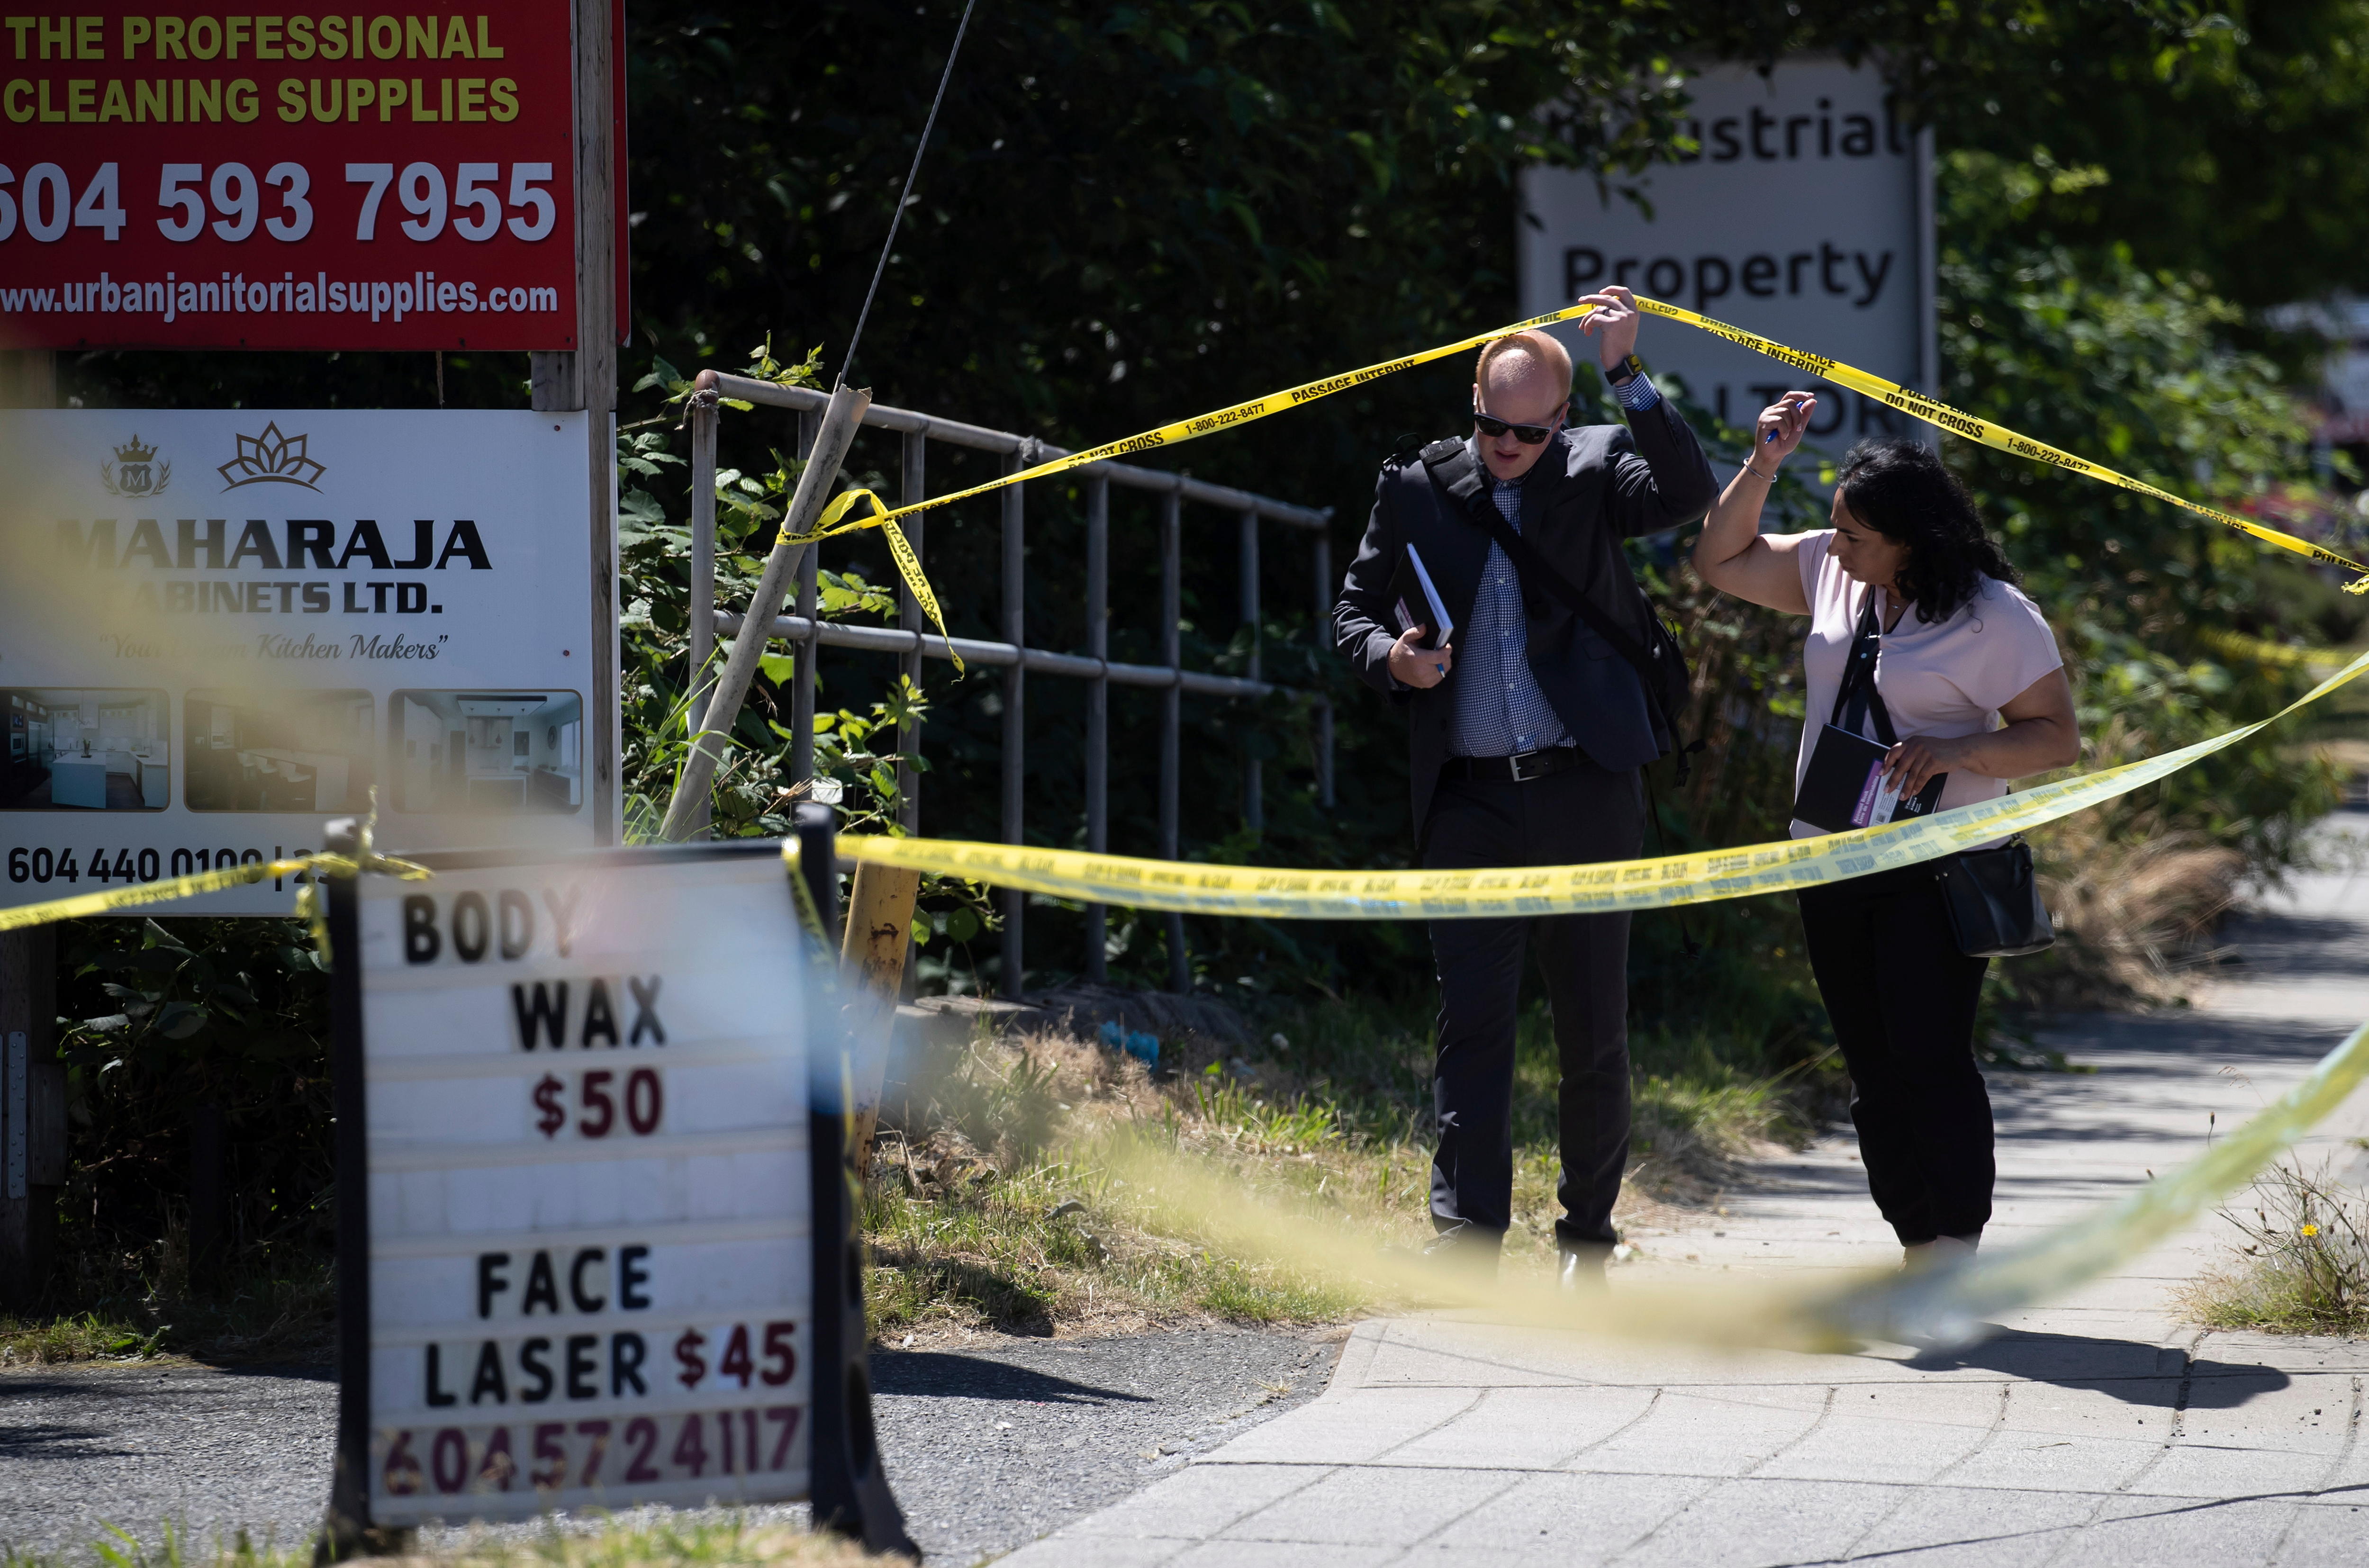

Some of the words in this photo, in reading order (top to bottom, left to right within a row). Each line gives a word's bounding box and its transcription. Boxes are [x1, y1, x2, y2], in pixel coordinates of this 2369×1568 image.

[5, 16, 104, 60] THE
[123, 15, 504, 60] PROFESSIONAL
[3, 78, 260, 123] CLEANING
[278, 77, 521, 123] SUPPLIES
[156, 162, 314, 242] 593
[345, 162, 556, 242] 7955
[1564, 242, 1895, 310] Property
[1291, 377, 1354, 404] PASSAGE
[1184, 403, 1266, 435] 1-800-222-8477
[1885, 392, 1904, 408] DO
[1907, 401, 1937, 420] NOT
[1937, 412, 1985, 440] CROSS
[1119, 432, 1165, 454] CROSS
[127, 472, 145, 488] M
[55, 519, 493, 569] MAHARAJA
[114, 581, 331, 614] ABINETS
[343, 582, 443, 614] LTD.
[256, 635, 342, 660] Kitchen
[350, 633, 449, 661] Makers”
[8, 847, 79, 883] 604
[88, 847, 160, 883] 440
[404, 888, 579, 964] BODY
[513, 977, 666, 1050] WAX
[532, 1069, 662, 1138] $50
[477, 1246, 651, 1318] FACE
[425, 1332, 646, 1407] LASER
[675, 1323, 796, 1390] $45
